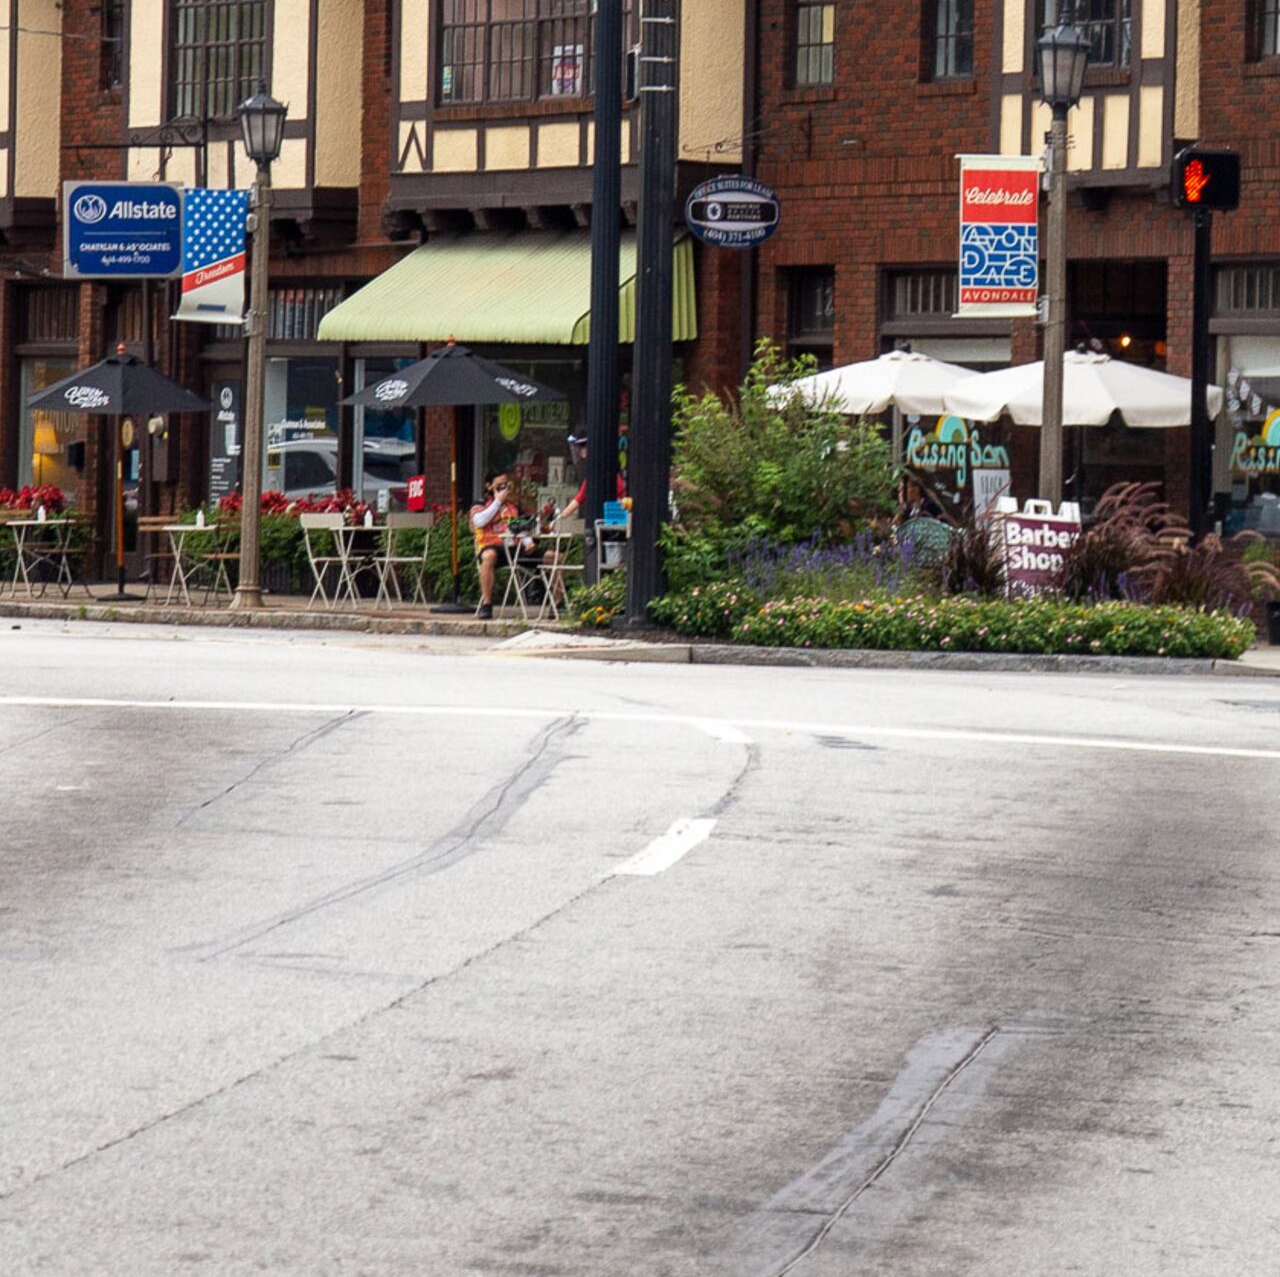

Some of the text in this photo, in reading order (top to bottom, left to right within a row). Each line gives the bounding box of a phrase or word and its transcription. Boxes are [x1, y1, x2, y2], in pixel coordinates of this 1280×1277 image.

[965, 186, 1034, 206] Celebrate
[108, 200, 177, 220] Allstate
[963, 289, 1033, 301] AVONDALE
[907, 427, 968, 489] Rising
